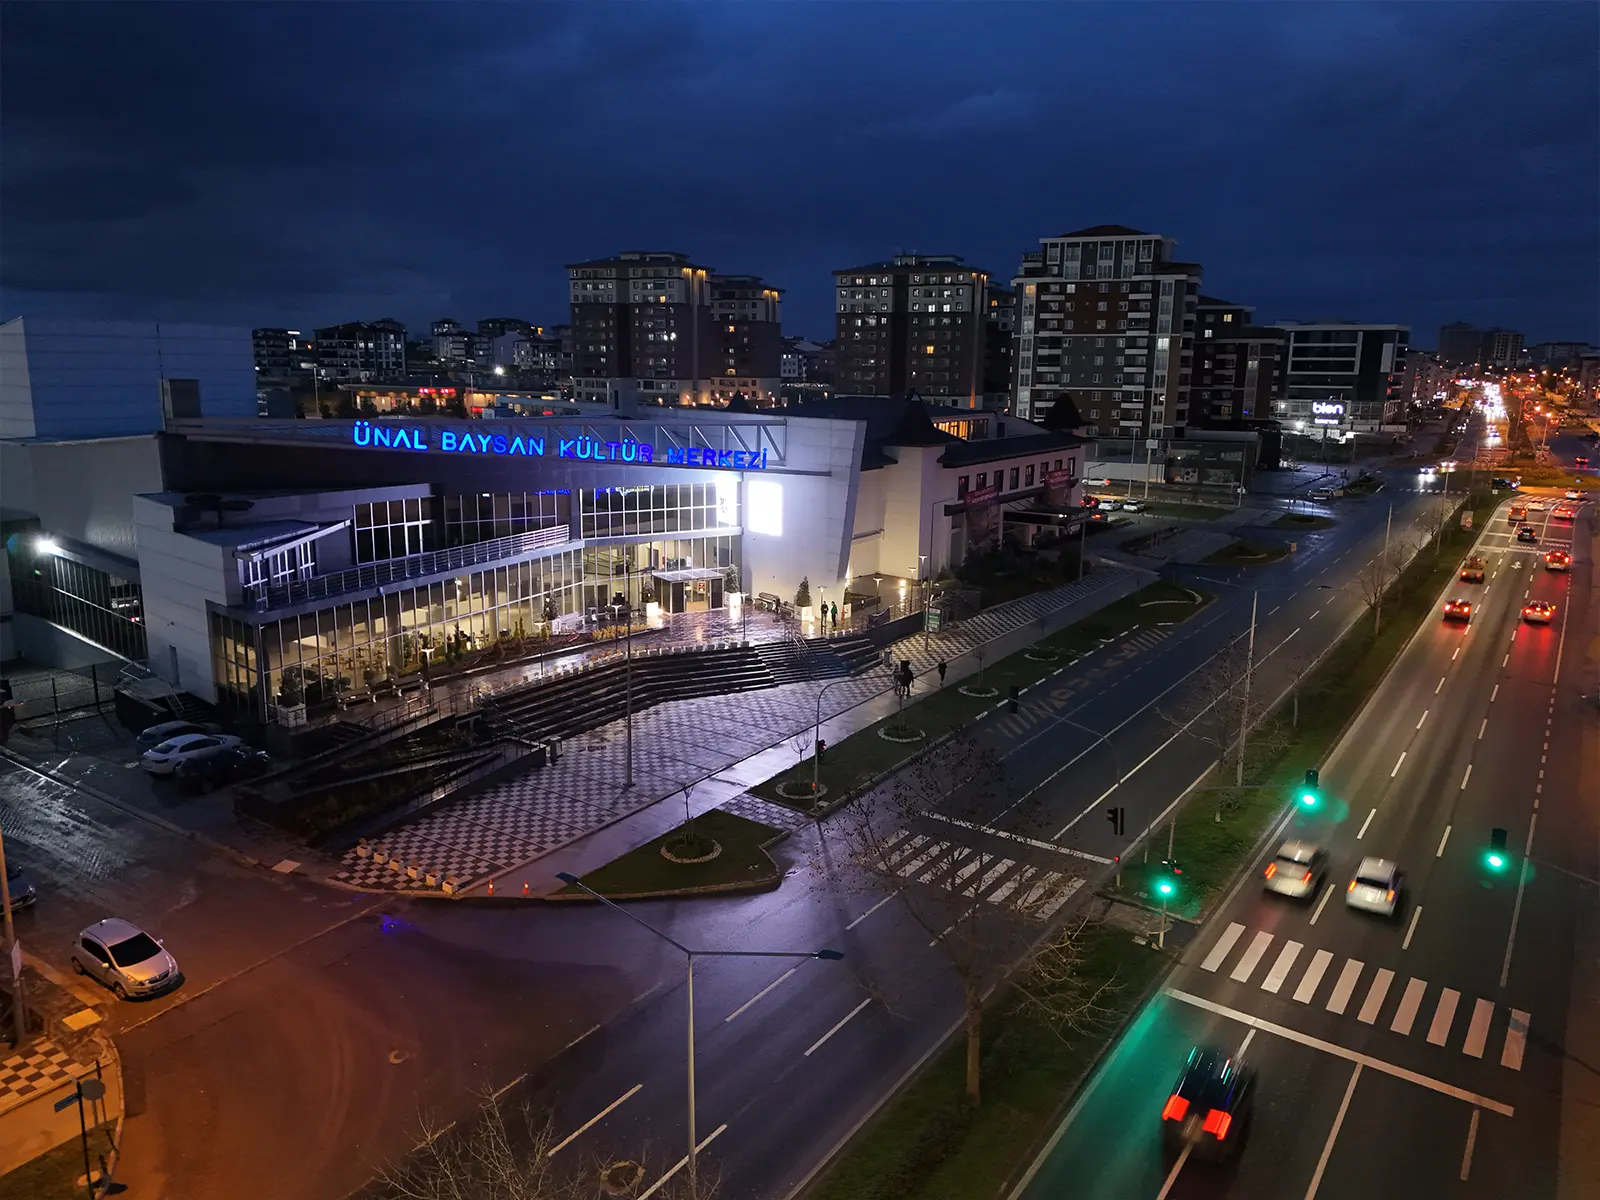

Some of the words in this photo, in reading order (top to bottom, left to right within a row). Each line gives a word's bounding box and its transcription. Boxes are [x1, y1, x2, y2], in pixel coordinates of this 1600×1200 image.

[353, 420, 427, 451] ÜNAL
[440, 430, 545, 457] BAYSAN
[559, 434, 653, 464] KÜLTÜR
[666, 446, 768, 470] MERKEZİ
